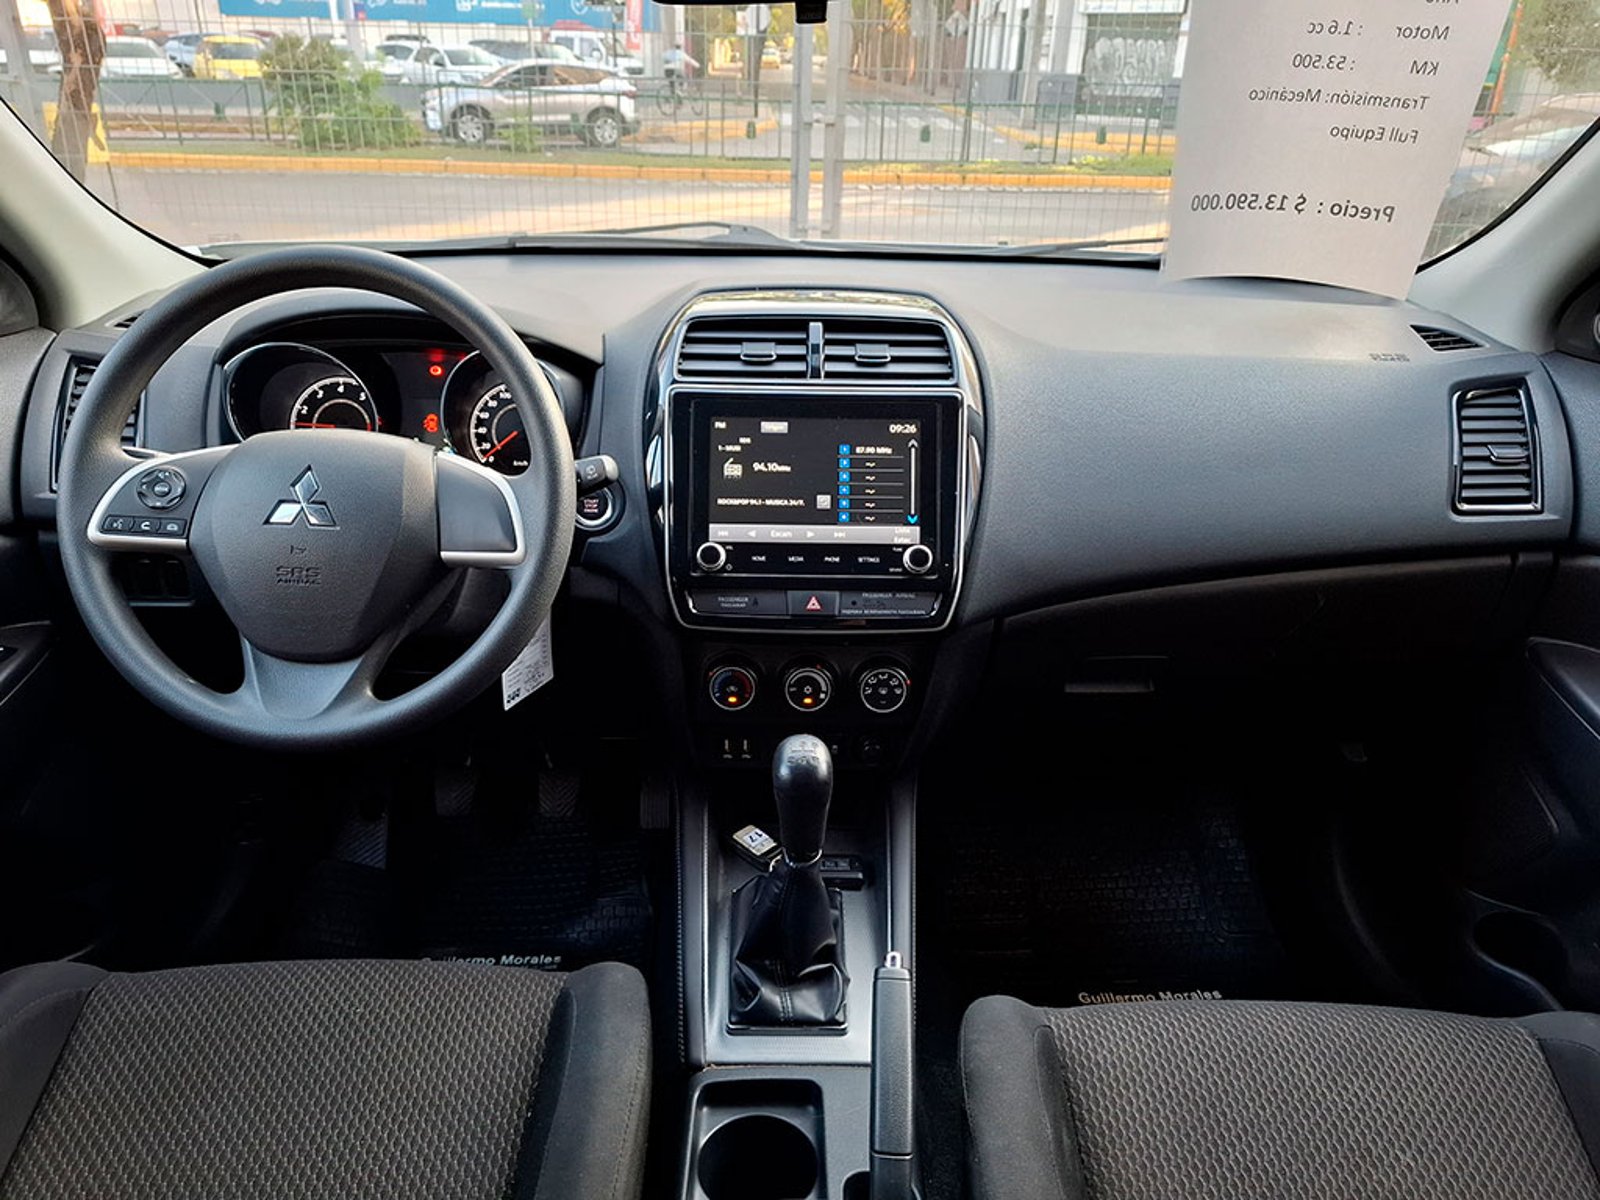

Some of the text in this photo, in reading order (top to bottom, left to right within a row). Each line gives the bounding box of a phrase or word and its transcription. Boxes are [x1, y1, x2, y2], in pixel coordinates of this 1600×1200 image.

[889, 424, 918, 434] 09:26
[500, 954, 562, 965] Morales
[1157, 988, 1223, 1001] Morales
